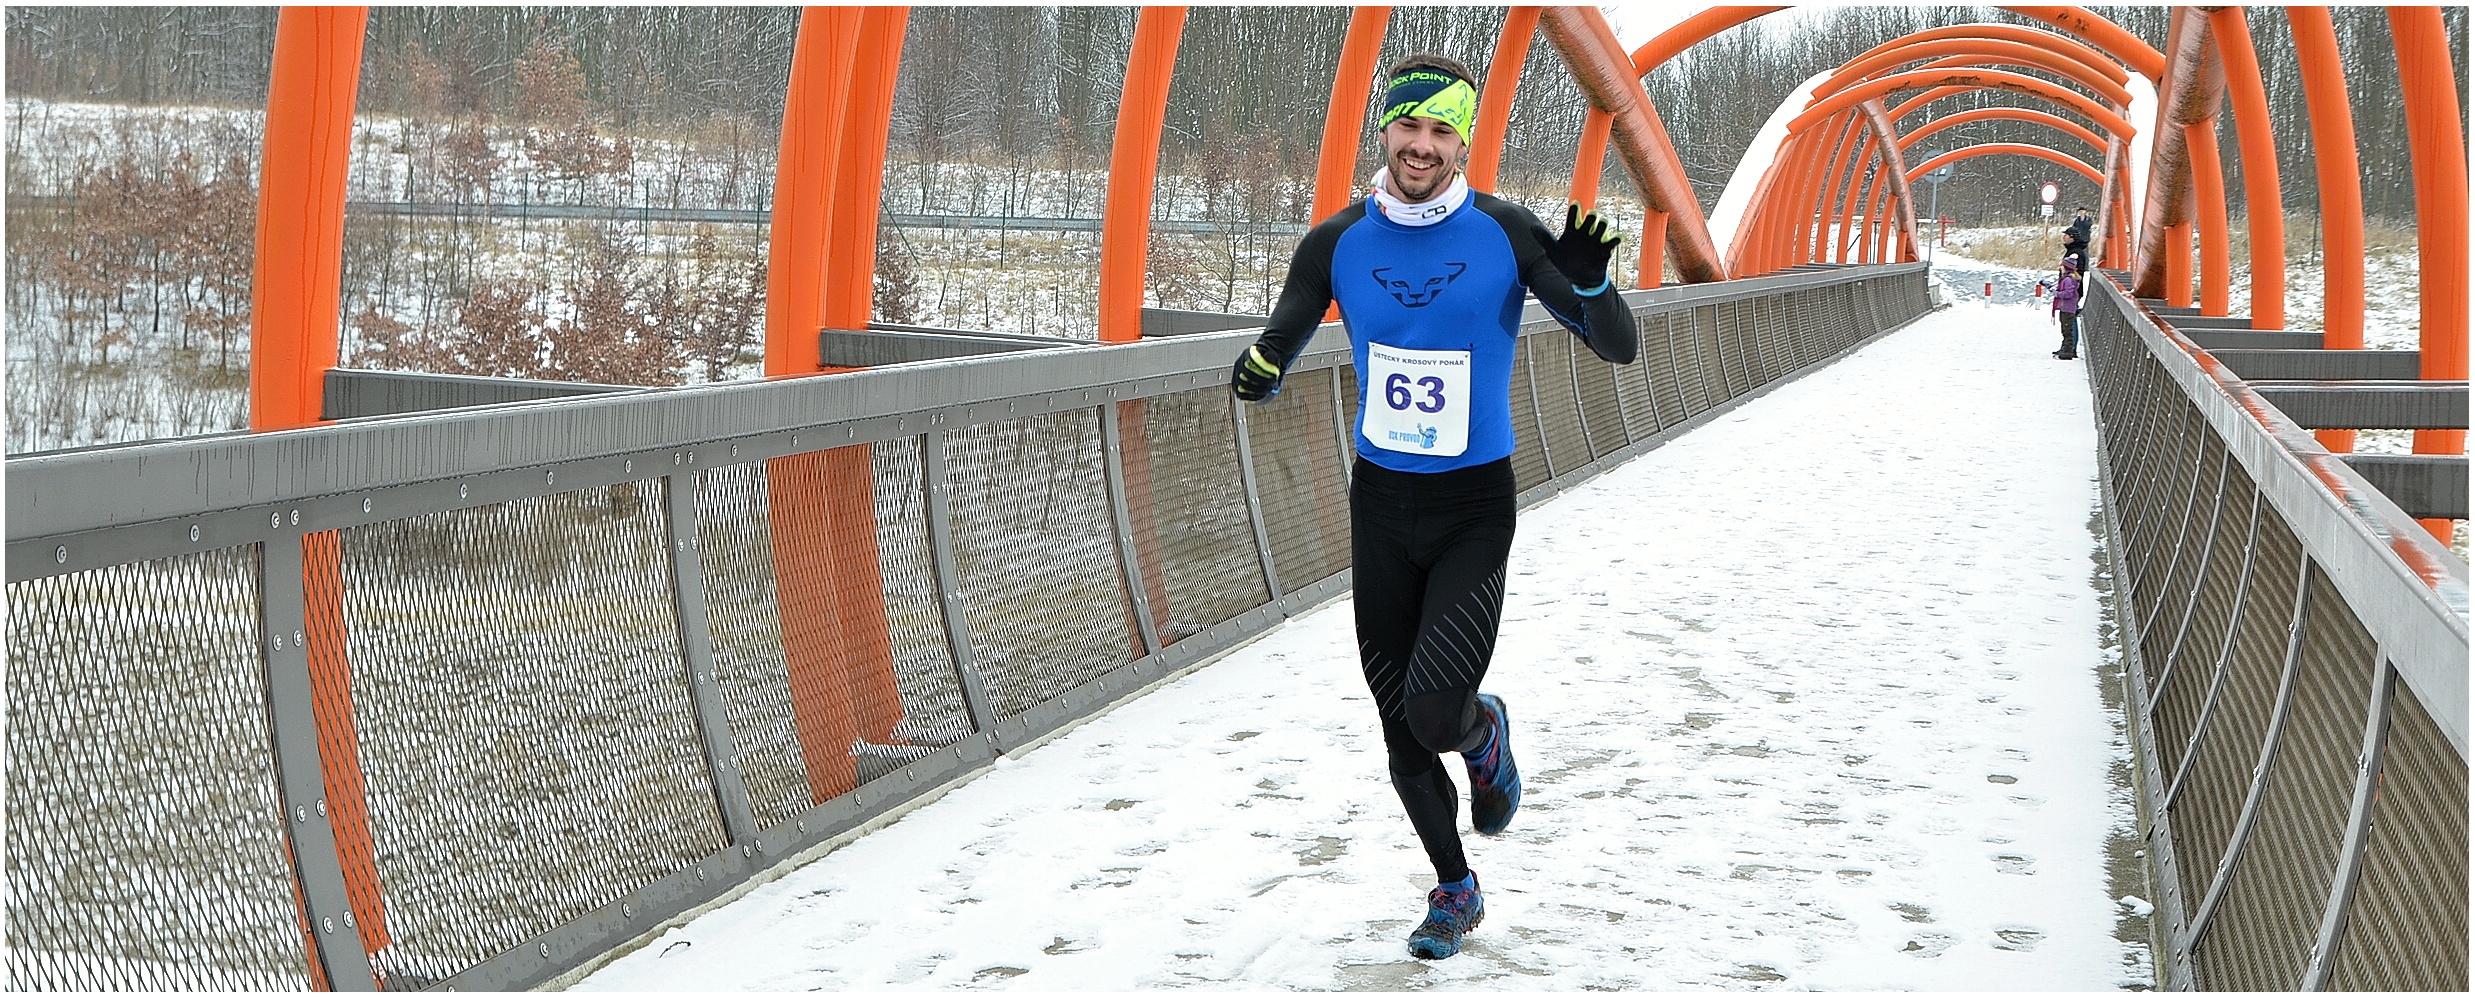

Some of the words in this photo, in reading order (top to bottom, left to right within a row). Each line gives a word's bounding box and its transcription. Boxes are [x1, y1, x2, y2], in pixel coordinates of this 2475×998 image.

[1410, 72, 1452, 85] POINT
[1402, 358, 1437, 366] KROSOVÝ
[1385, 373, 1446, 413] 63
